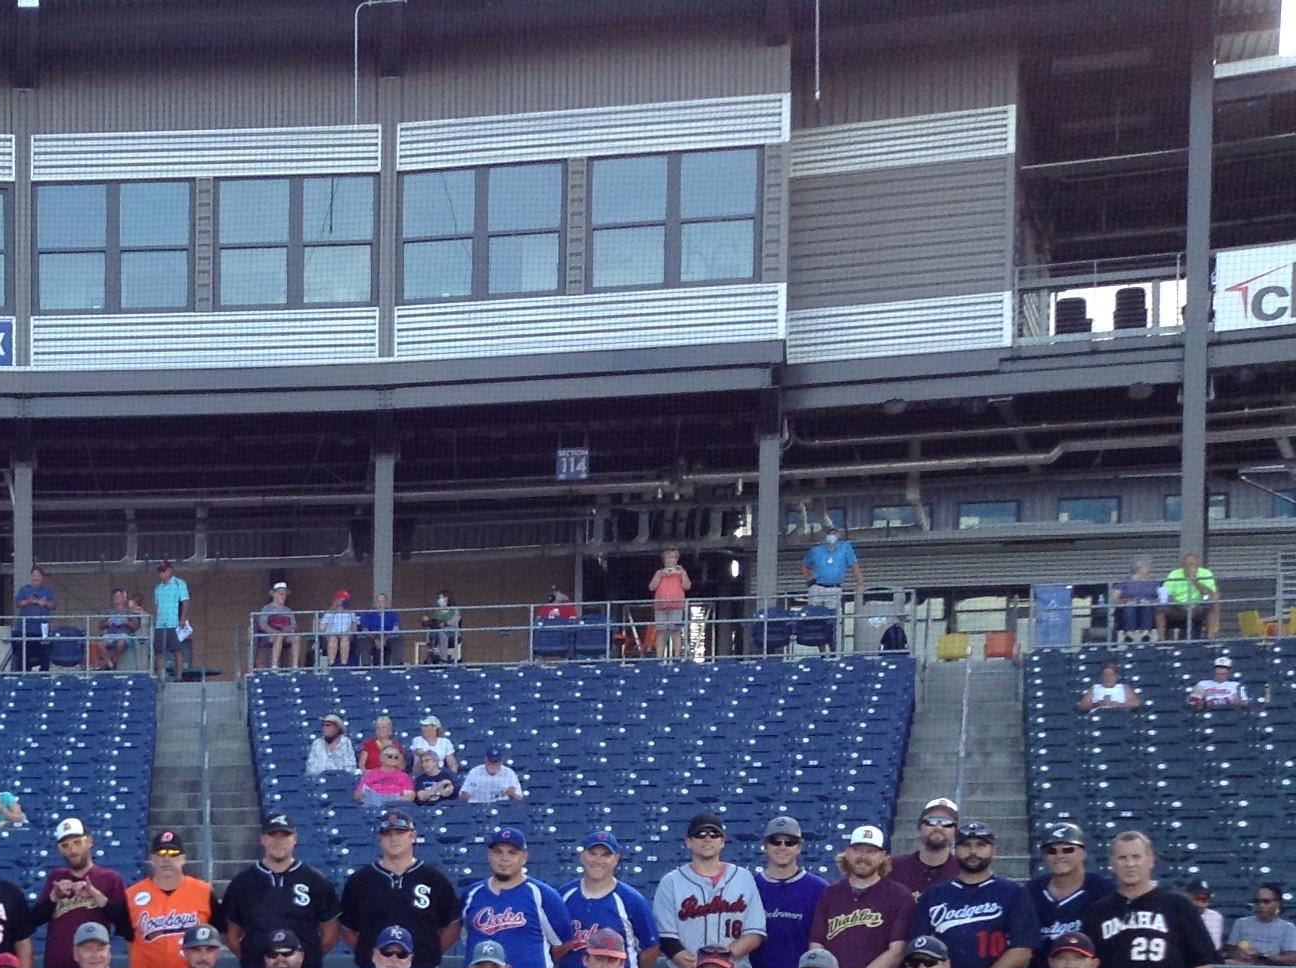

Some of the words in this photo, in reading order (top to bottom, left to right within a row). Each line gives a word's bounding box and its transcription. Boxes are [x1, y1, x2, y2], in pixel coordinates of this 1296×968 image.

[561, 456, 588, 473] 114
[294, 883, 311, 907] S
[414, 883, 432, 909] S
[138, 908, 200, 937] Cowboys
[473, 905, 528, 936] Cubs
[929, 902, 1003, 932] Dodgers
[1130, 936, 1166, 962] 29
